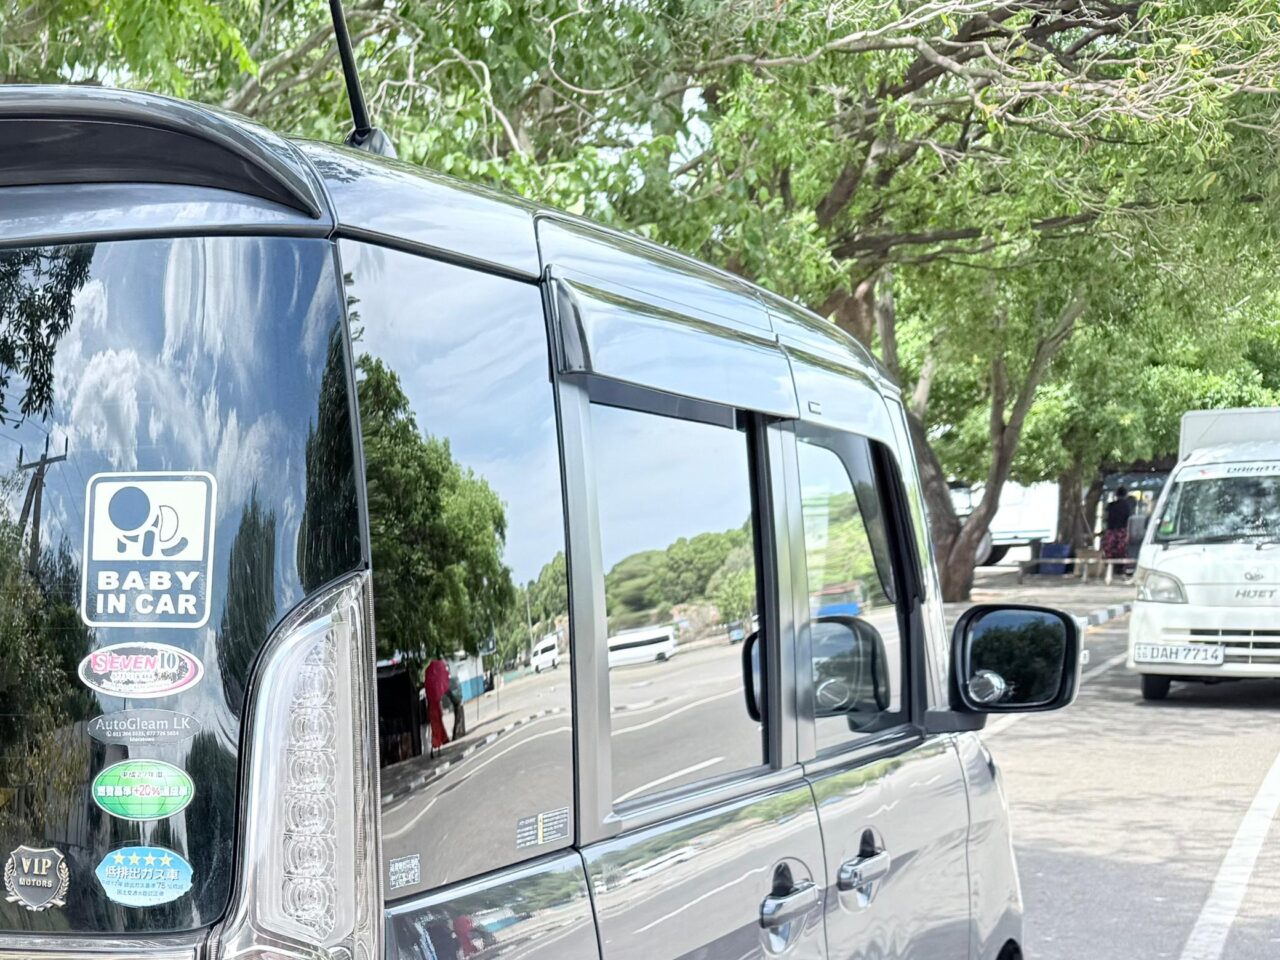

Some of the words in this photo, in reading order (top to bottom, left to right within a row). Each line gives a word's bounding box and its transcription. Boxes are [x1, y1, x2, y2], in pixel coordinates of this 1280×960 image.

[97, 571, 200, 591] BABY
[1235, 589, 1277, 599] HIJET
[96, 594, 125, 614] IN
[136, 593, 197, 615] CAR
[1150, 647, 1178, 659] DAH
[1183, 648, 1219, 660] 7714
[91, 653, 158, 673] SEVEN
[95, 717, 168, 730] AutoGleam
[173, 717, 190, 729] LK
[21, 857, 52, 875] VIP
[106, 865, 181, 881] 低排出ガス車
[19, 877, 53, 888] MOTORS
